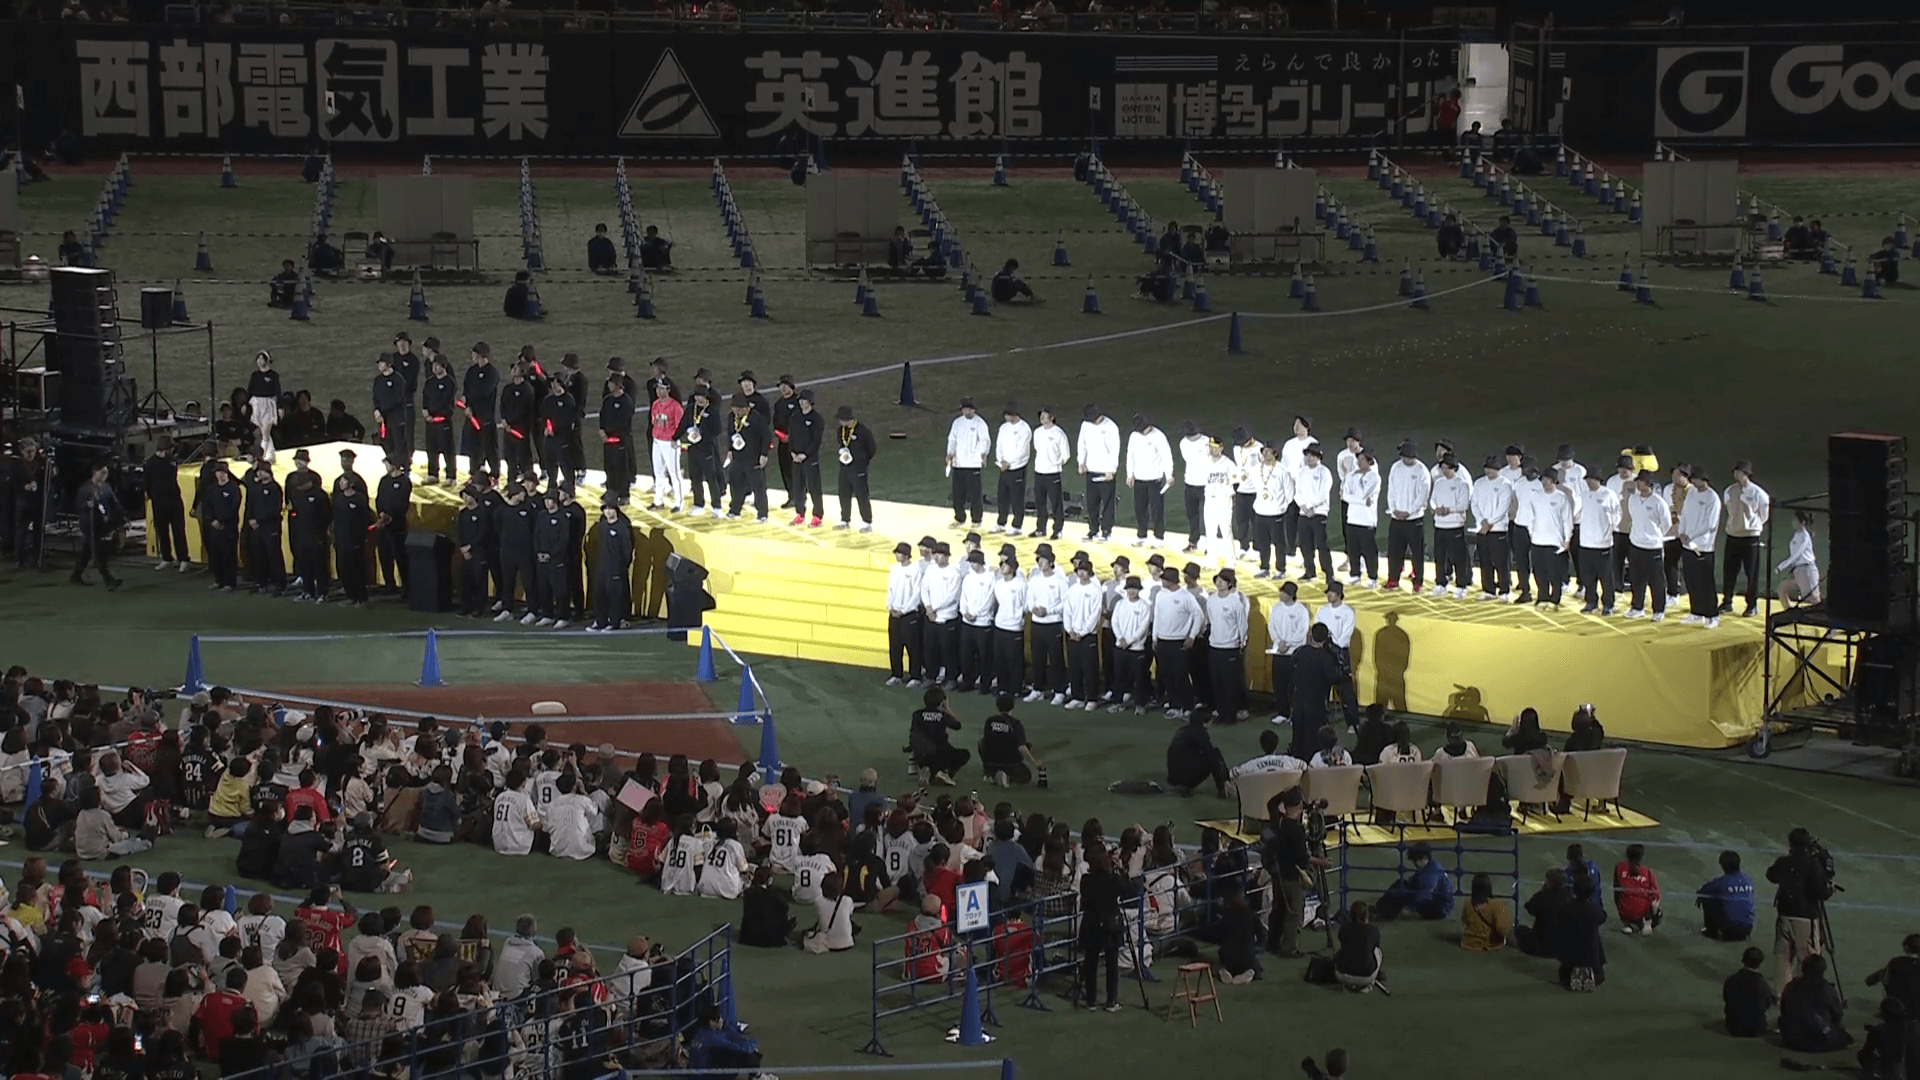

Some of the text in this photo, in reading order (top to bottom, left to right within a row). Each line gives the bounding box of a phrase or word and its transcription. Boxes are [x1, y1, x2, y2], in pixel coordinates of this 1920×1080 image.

[1235, 48, 1440, 72] えらんで良かった
[76, 38, 549, 141] 西部電気工業
[744, 50, 1042, 137] 英進館
[1122, 104, 1161, 114] GREEN
[1122, 115, 1161, 124] HOTEL
[185, 763, 202, 781] 24
[542, 786, 552, 803] 9
[496, 803, 511, 821] 61
[775, 828, 793, 846] 61
[668, 848, 688, 868] 28
[707, 848, 727, 868] 49
[890, 852, 900, 871] 8
[800, 869, 811, 887] 8
[966, 890, 980, 911] A
[145, 909, 163, 929] 23
[393, 996, 406, 1016] 9
